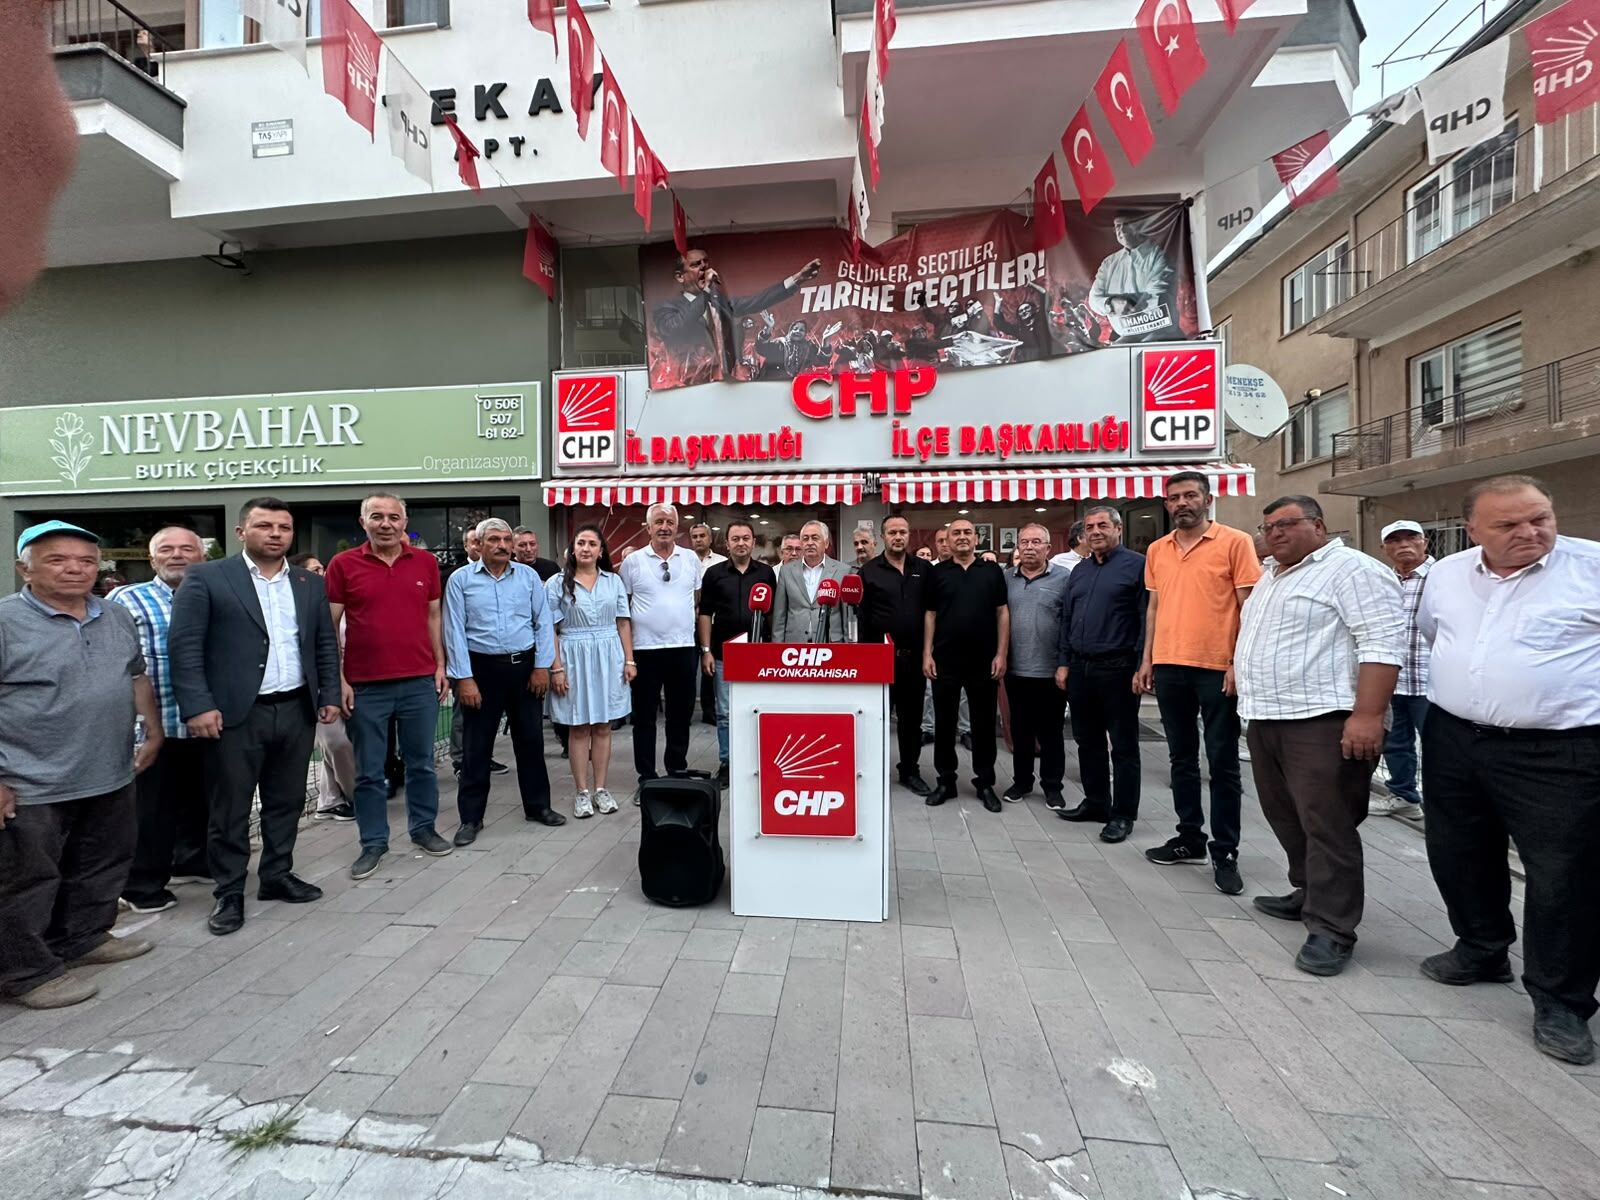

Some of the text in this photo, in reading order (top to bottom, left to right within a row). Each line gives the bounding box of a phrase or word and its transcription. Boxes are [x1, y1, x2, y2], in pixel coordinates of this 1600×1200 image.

[917, 240, 997, 276] SEÇTİLER,
[800, 250, 1046, 314] TARİHE GEÇTİLER!
[483, 398, 519, 410] 0 506
[791, 366, 938, 419] CHP
[100, 403, 364, 455] NEVBAHAR
[490, 413, 512, 424] 507
[1150, 415, 1211, 441] CHP
[501, 427, 517, 438] 62
[891, 415, 1129, 461] İLÇE BAŞKANLIĞI
[562, 435, 611, 459] CHP
[626, 425, 803, 469] İL BAŞKANLIĞI
[136, 455, 324, 481] BUTİK ÇİÇEKÇİLİK
[422, 454, 529, 473] Organizasyon
[752, 587, 768, 602] 3
[781, 647, 833, 667] CHP
[757, 667, 857, 679] AFYONKARAHİSAR
[773, 789, 845, 816] CHP
